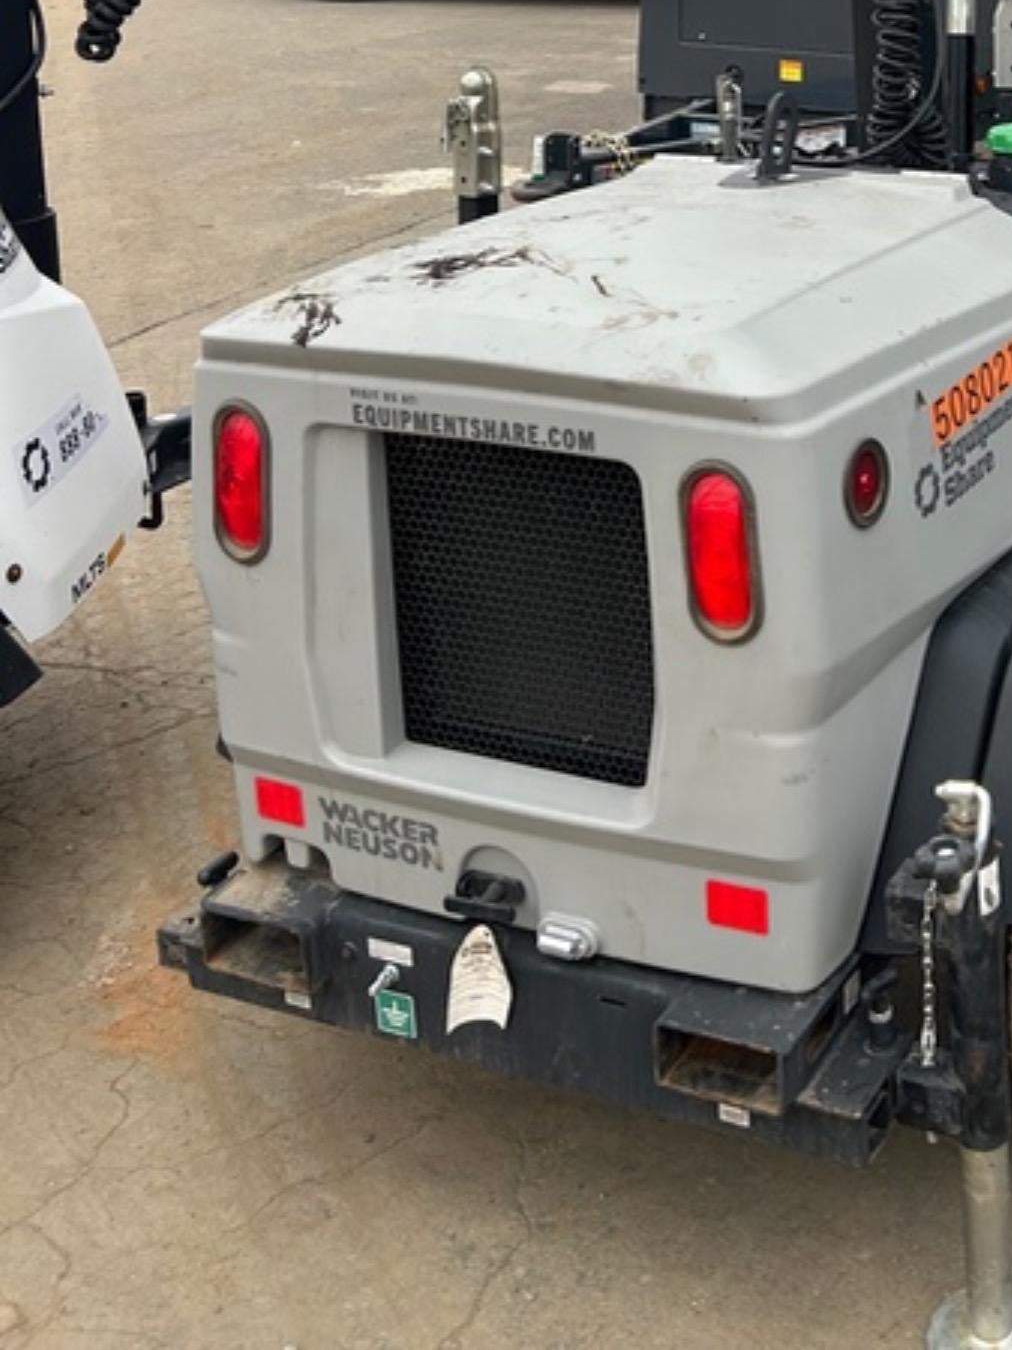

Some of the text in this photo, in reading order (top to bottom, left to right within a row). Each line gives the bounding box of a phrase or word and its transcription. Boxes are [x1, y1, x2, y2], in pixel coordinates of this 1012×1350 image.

[352, 404, 596, 452] EQUIPMENTSHARE.COM
[945, 450, 995, 507] Share
[318, 796, 439, 846] WACKER
[323, 821, 443, 872] NEUSON
